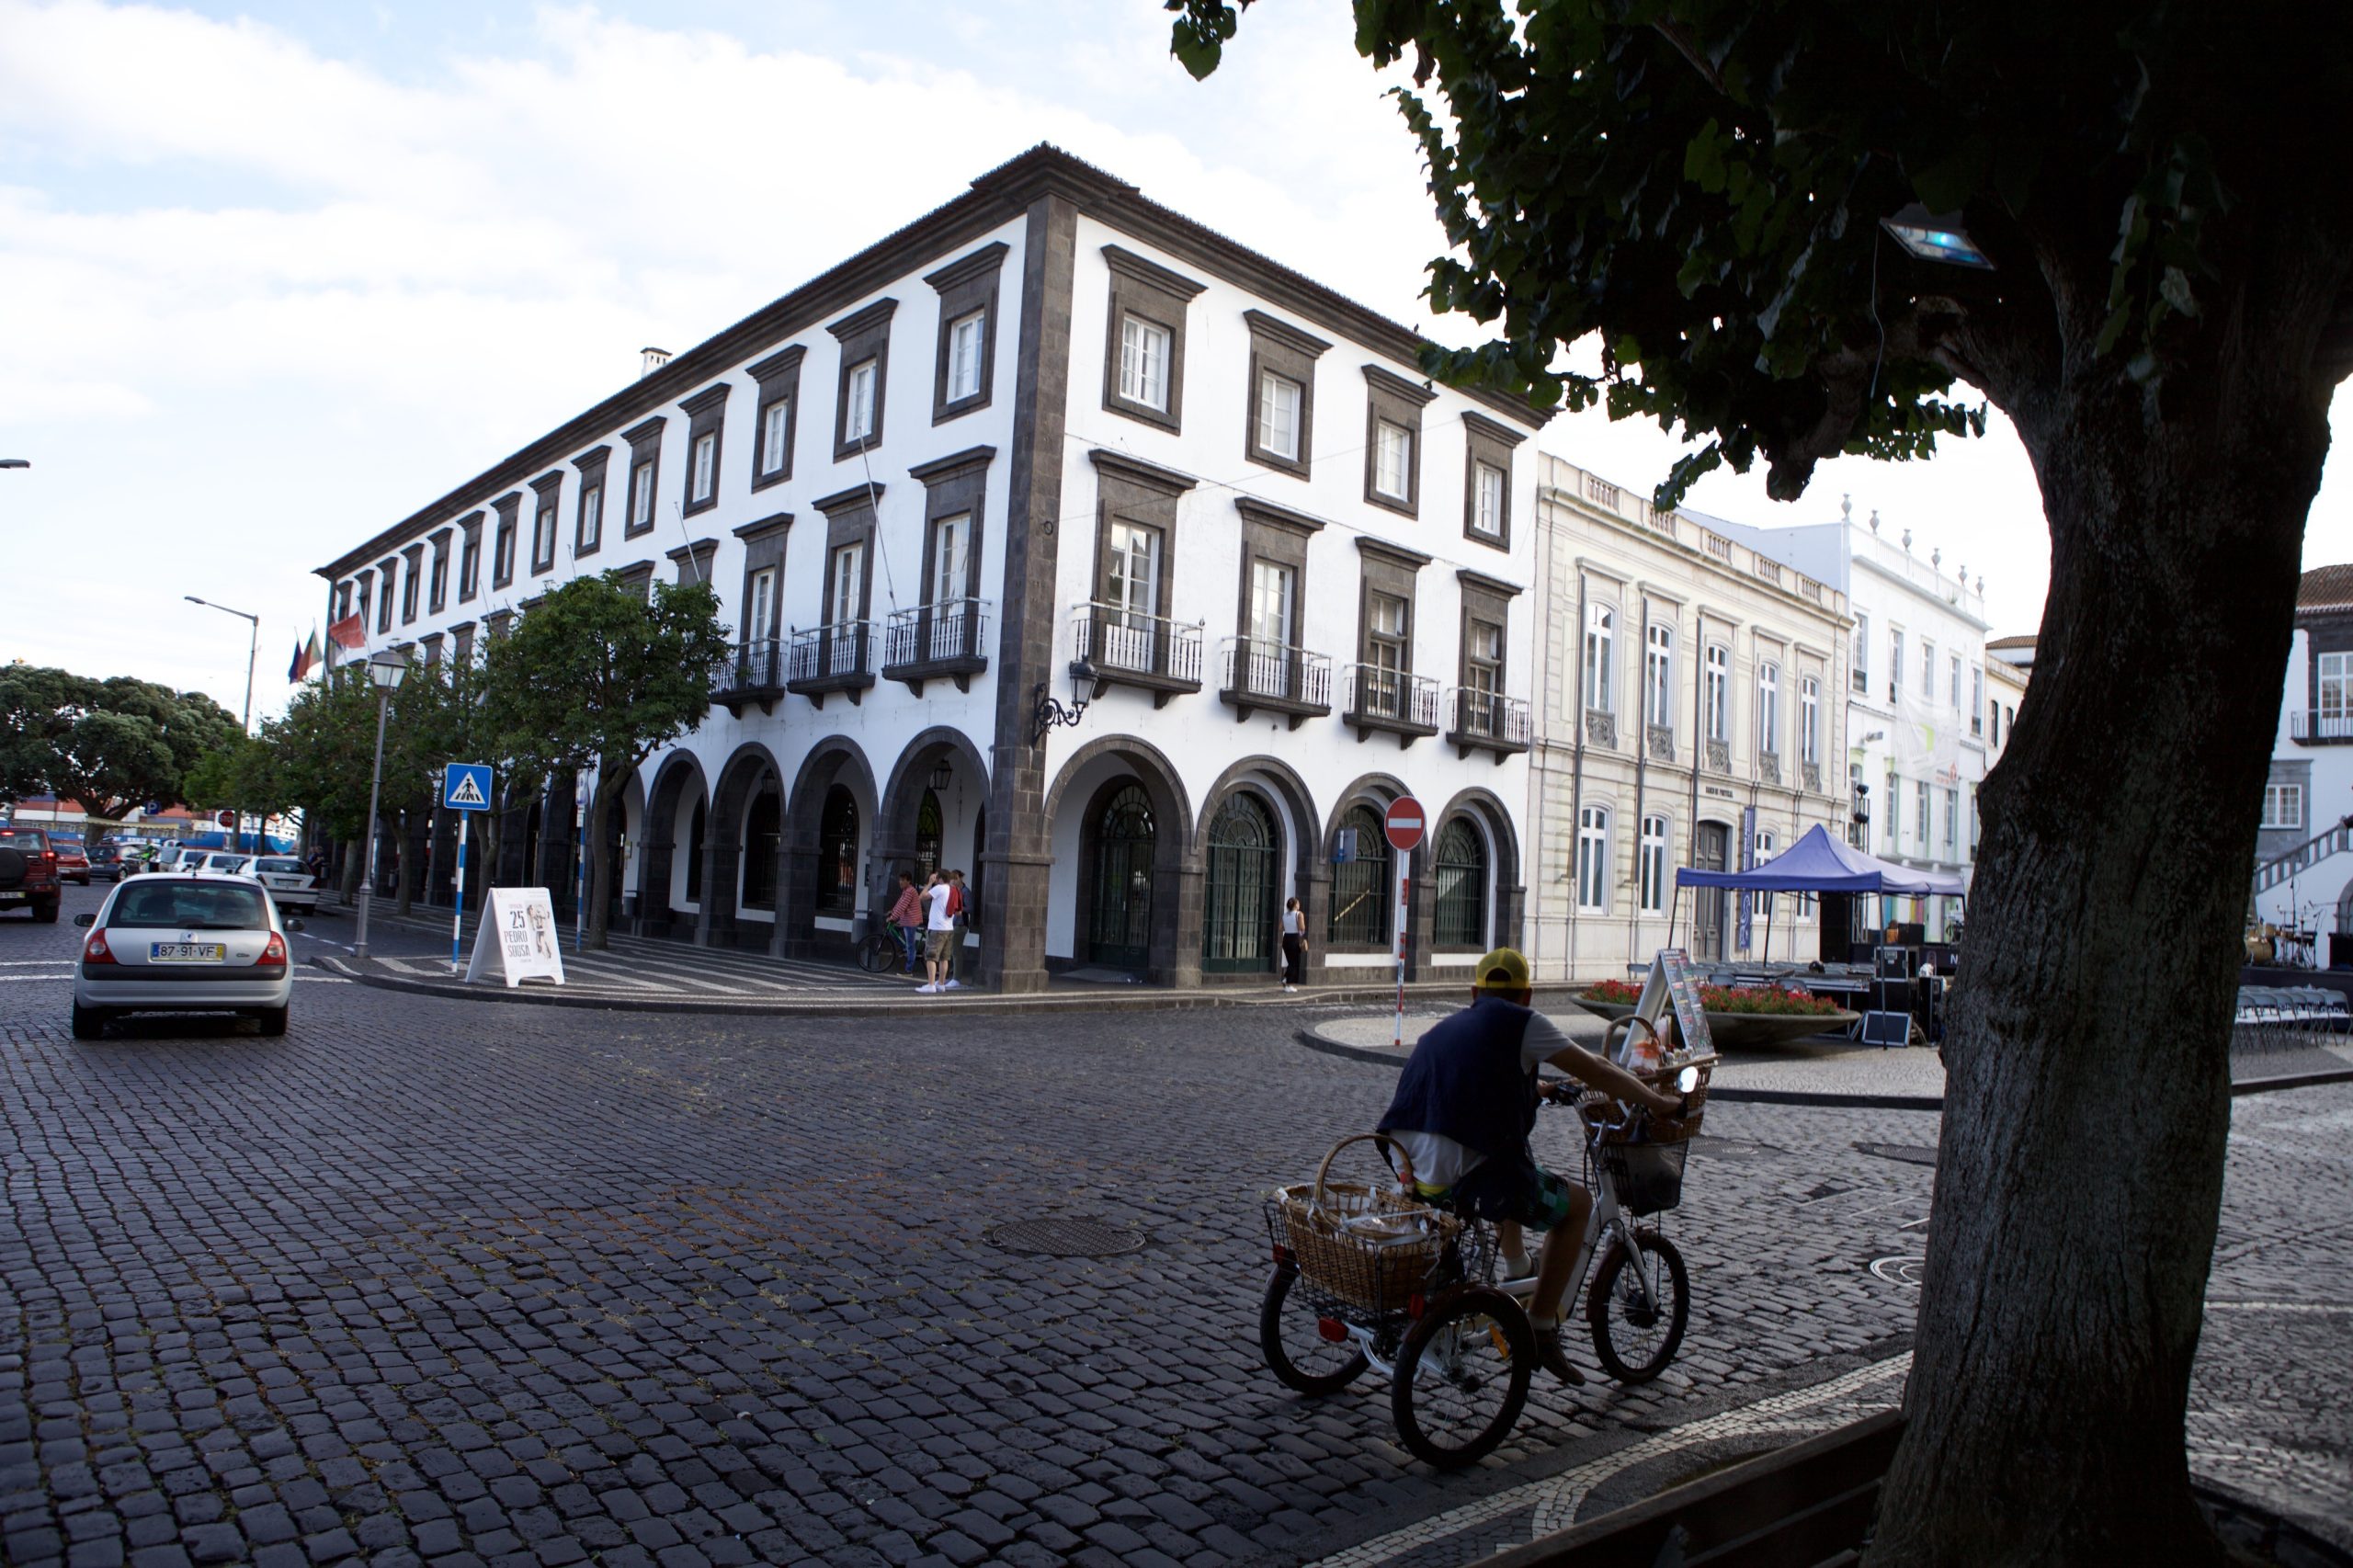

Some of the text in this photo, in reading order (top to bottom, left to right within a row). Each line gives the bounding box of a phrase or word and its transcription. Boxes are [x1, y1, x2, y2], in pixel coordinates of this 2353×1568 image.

[148, 802, 158, 812] P
[509, 910, 526, 929] 25
[504, 930, 529, 944] PEDRO
[160, 946, 216, 957] 87-91-VF
[507, 944, 531, 958] SOUSA
